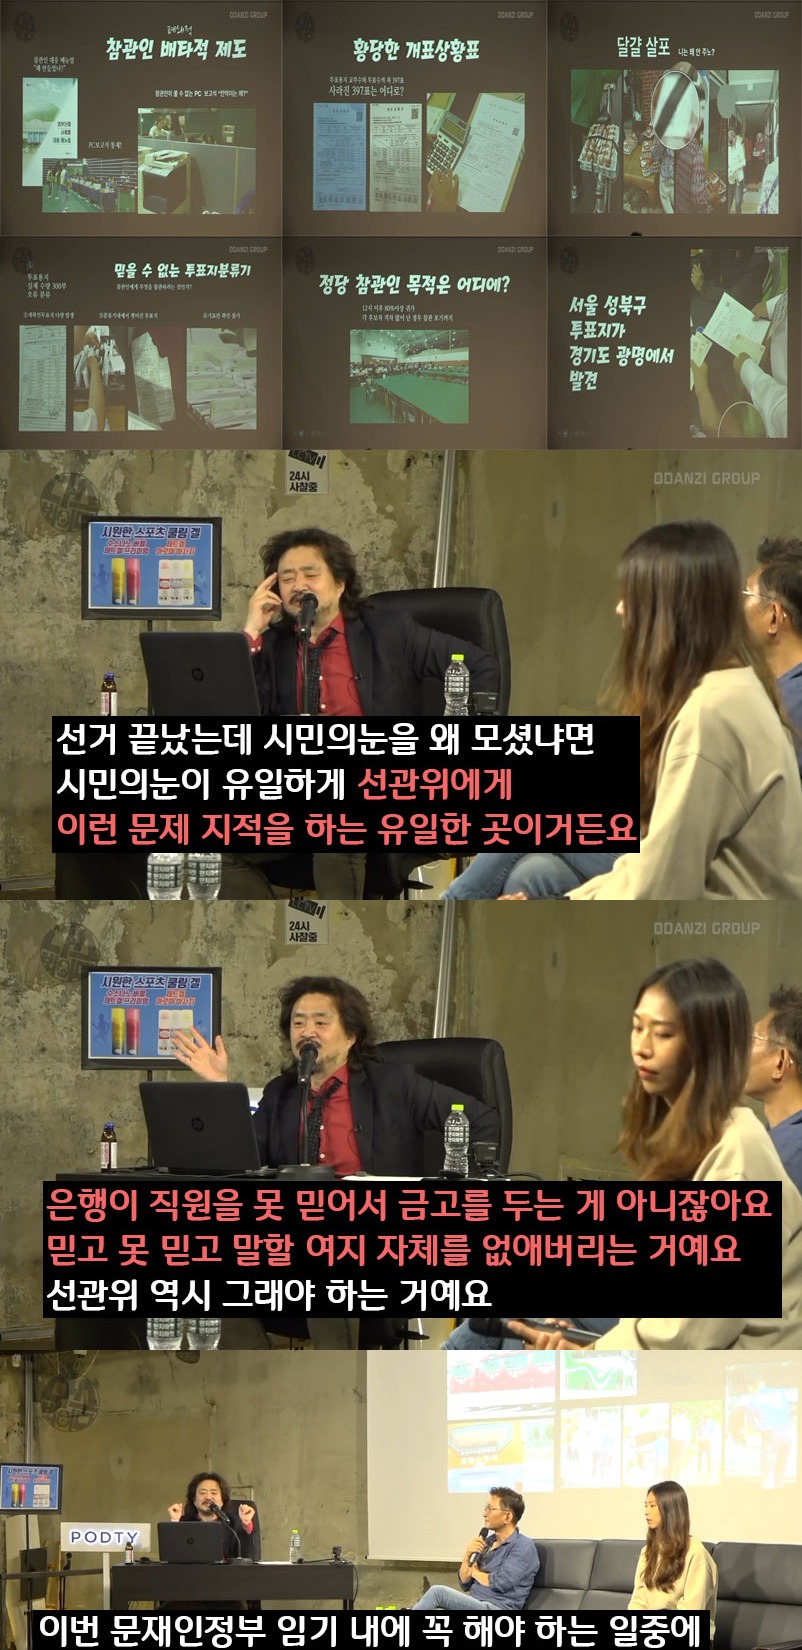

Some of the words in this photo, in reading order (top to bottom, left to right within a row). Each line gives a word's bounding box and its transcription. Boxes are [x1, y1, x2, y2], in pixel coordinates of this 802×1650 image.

[106, 38, 154, 60] 참관인
[160, 38, 209, 60] 배타적
[215, 39, 246, 58] 제도
[353, 38, 400, 62] 황당한
[406, 39, 480, 62] 개표상황표
[617, 36, 642, 58] 달걀
[646, 36, 670, 58] 살포
[689, 48, 694, 57] 왜
[695, 48, 701, 57] 안
[328, 85, 350, 97] 사라진
[352, 85, 378, 97] 397표는
[379, 85, 404, 97] 어디로?
[114, 262, 137, 278] 믿을
[142, 263, 153, 278] 수
[157, 263, 180, 278] 없는
[185, 263, 252, 278] 투표지분류기
[319, 274, 349, 295] 정당
[355, 274, 401, 295] 참관인
[407, 274, 451, 295] 목적은
[457, 276, 510, 292] 어디에?
[569, 294, 598, 316] 서울
[604, 295, 646, 316] 성북구
[569, 320, 626, 340] 투표지가
[570, 346, 610, 366] 경기도
[616, 346, 674, 366] 광명에서
[569, 371, 598, 391] 발견
[289, 471, 310, 481] 24시
[289, 482, 317, 492] 사찰중
[102, 527, 134, 538] 시원한
[134, 528, 165, 538] 스포츠
[168, 528, 188, 538] 쿨링
[190, 527, 200, 539] 겔
[71, 1530, 138, 1544] PODTY
